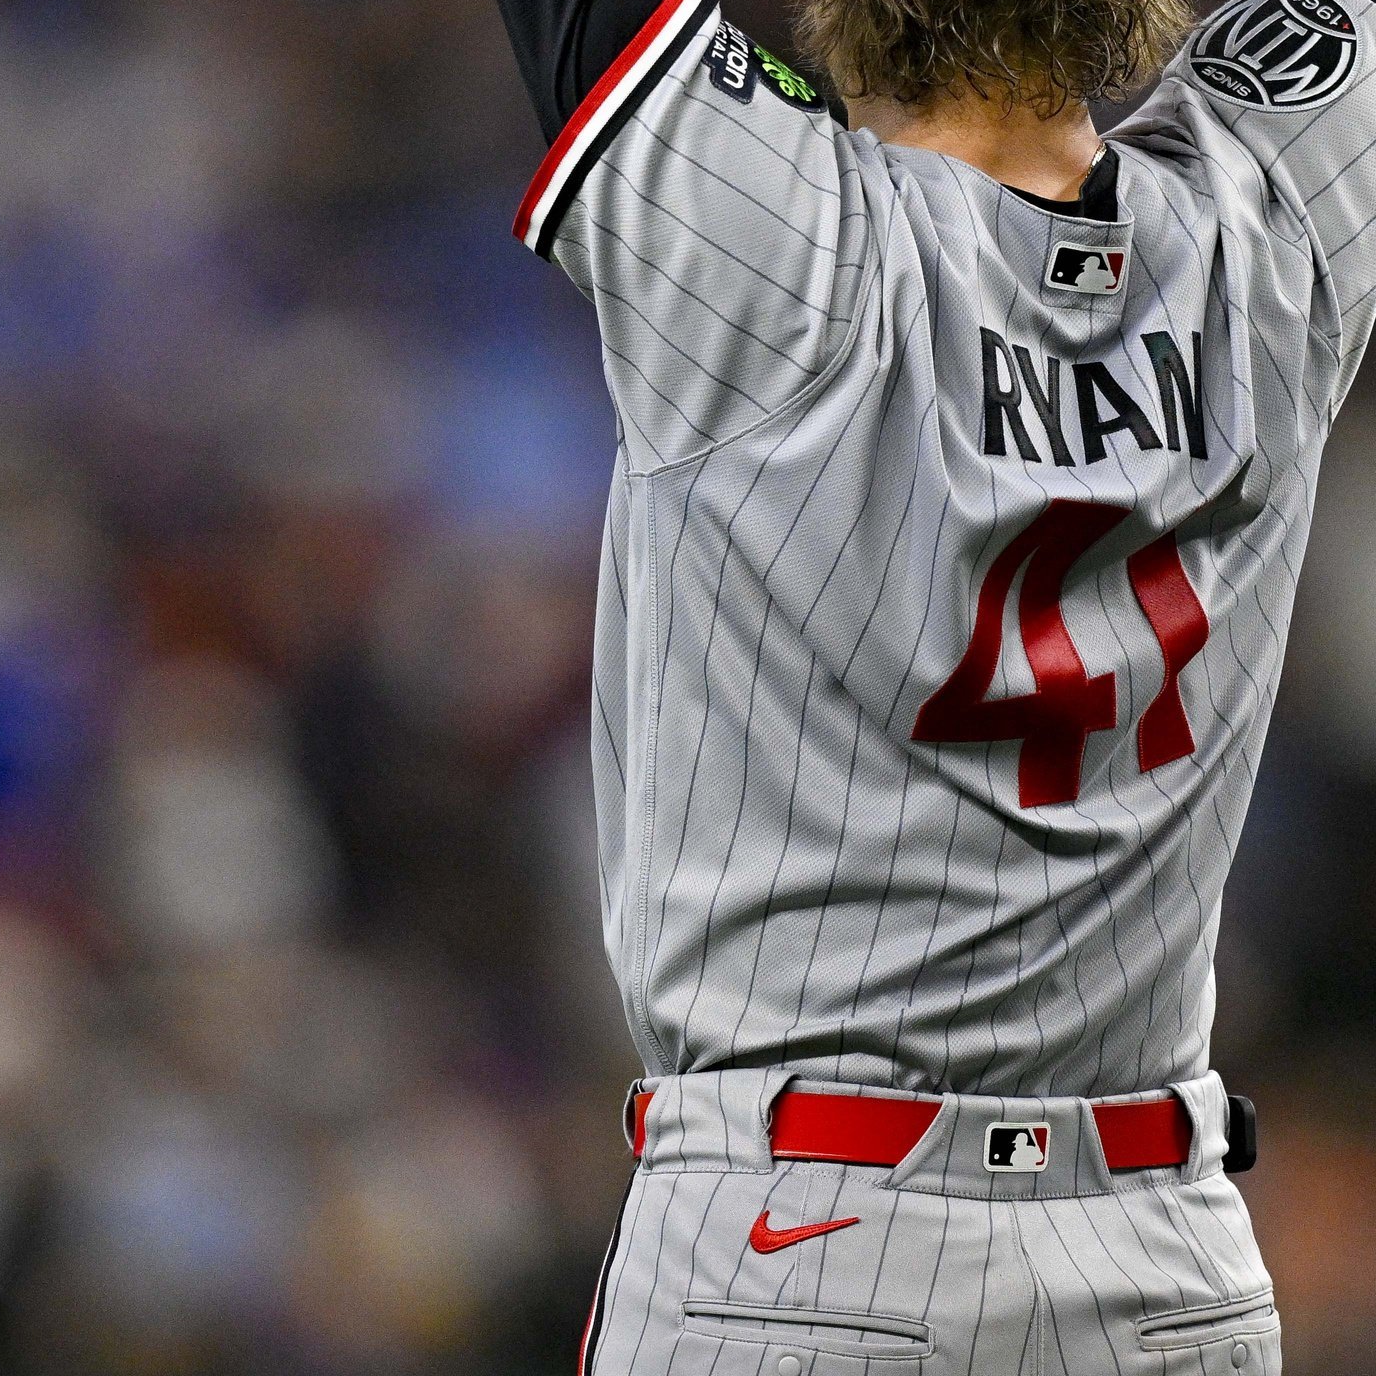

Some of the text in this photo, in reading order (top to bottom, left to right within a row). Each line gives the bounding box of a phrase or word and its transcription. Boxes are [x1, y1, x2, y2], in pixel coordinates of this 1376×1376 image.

[1201, 65, 1252, 97] SINCE
[979, 326, 1209, 468] RYAN
[910, 497, 1211, 809] 41
